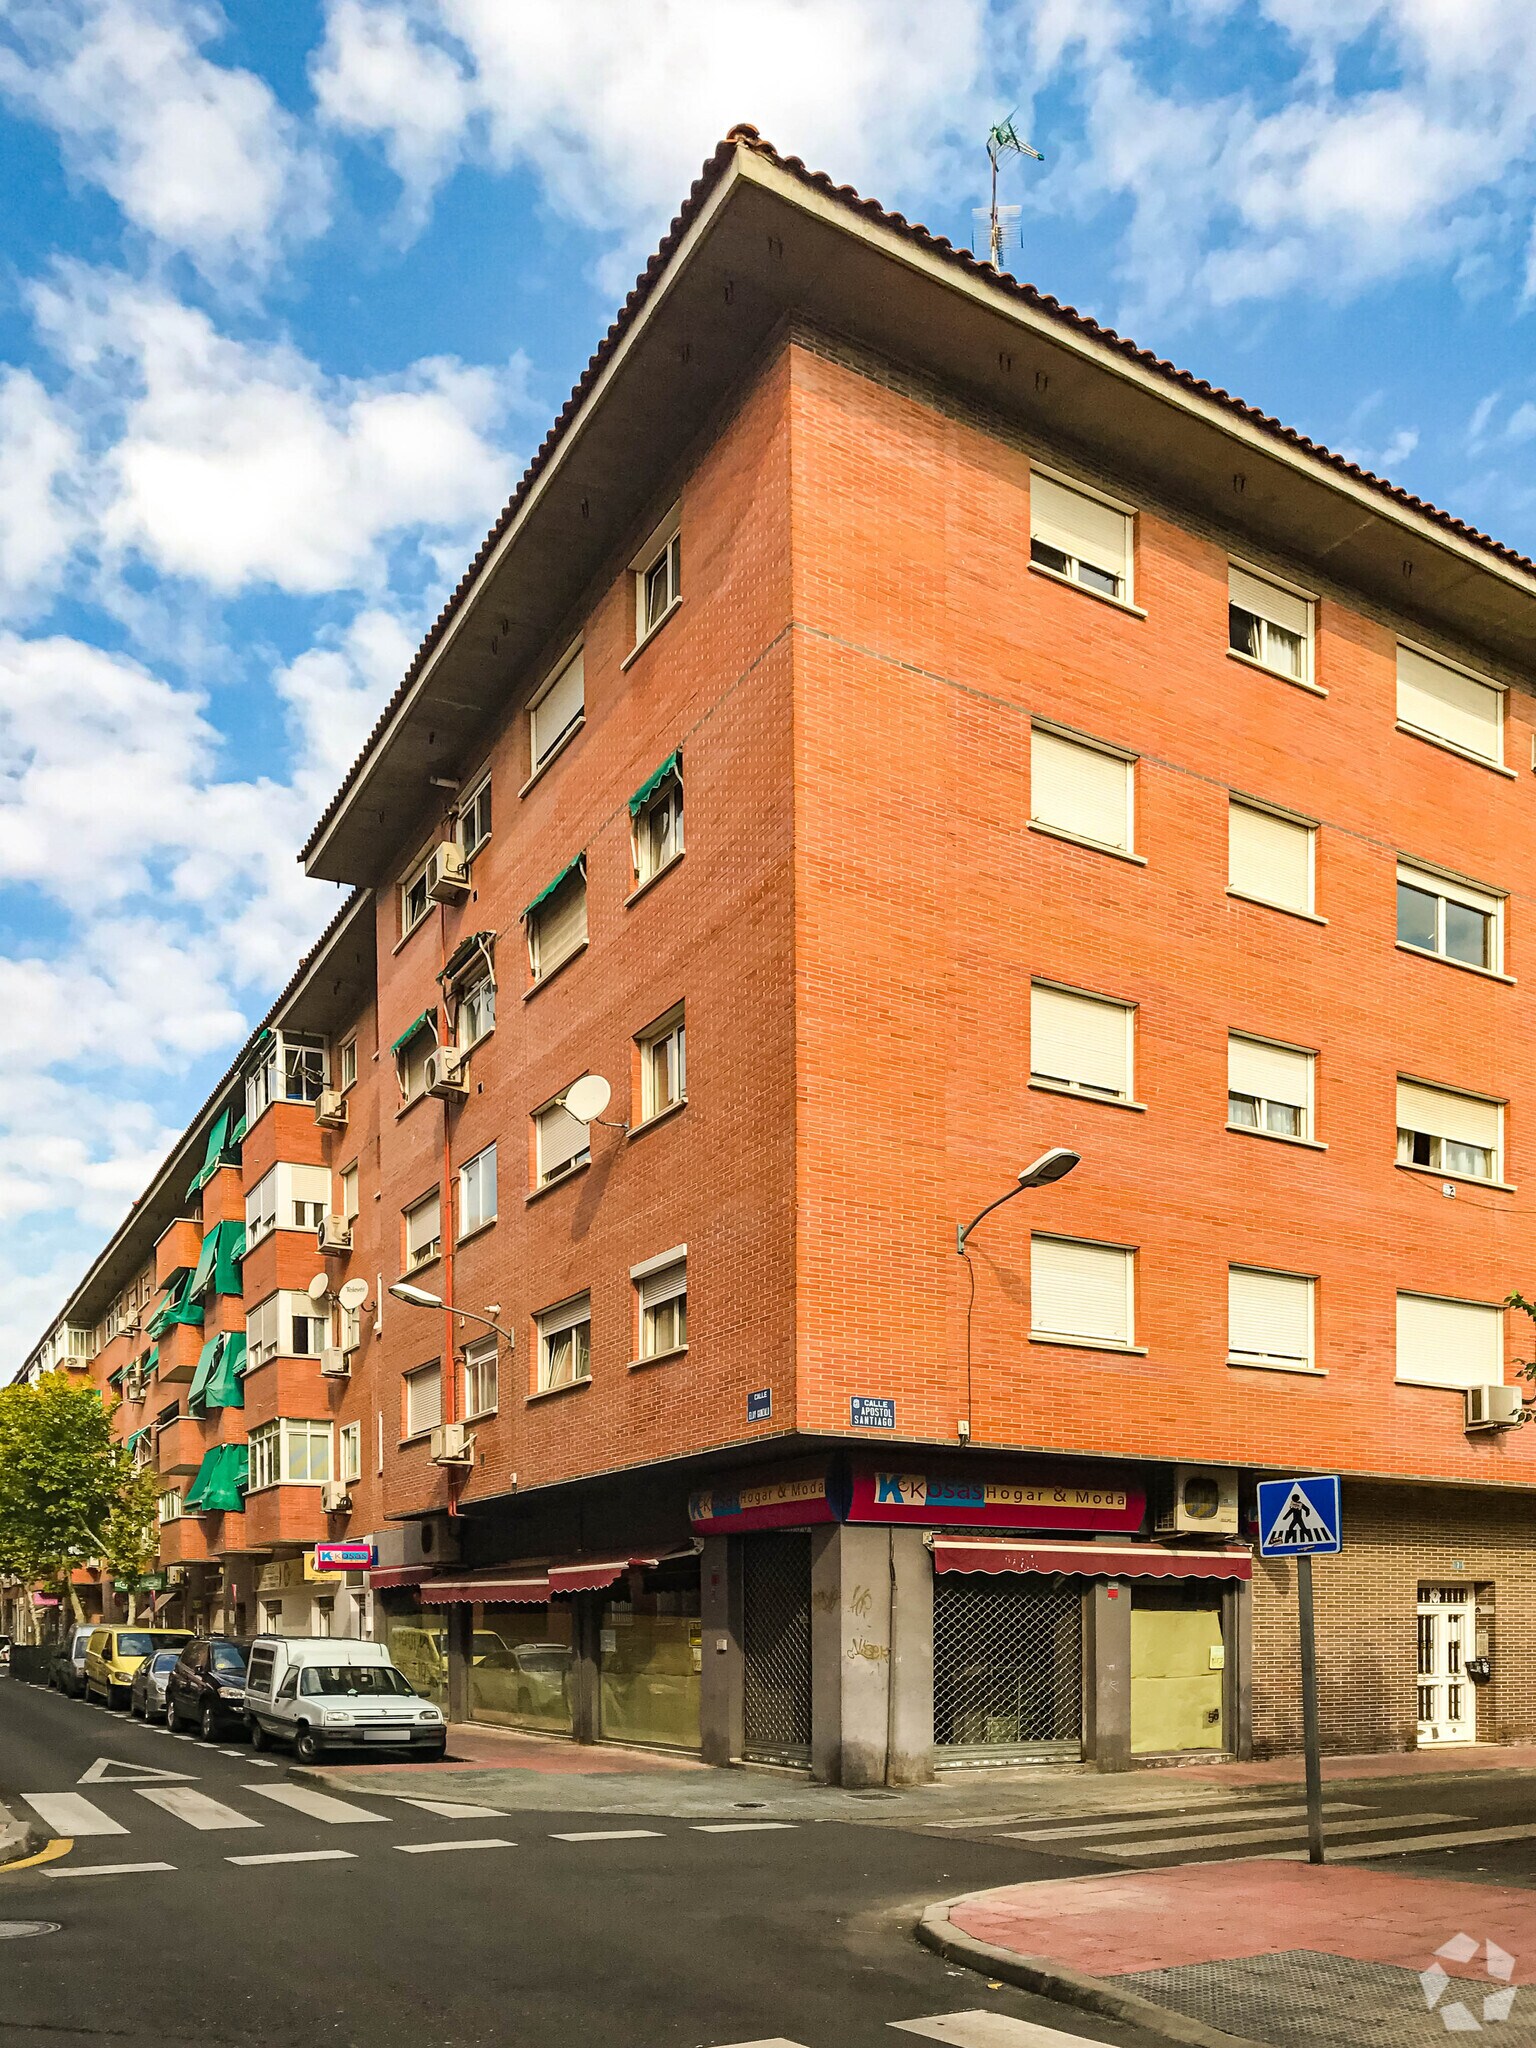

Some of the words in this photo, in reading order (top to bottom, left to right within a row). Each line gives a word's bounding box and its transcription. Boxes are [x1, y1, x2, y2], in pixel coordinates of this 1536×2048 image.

[754, 1391, 768, 1400] CALLE
[864, 1400, 888, 1408] CALLE
[861, 1407, 893, 1418] APOSTOL
[854, 1415, 893, 1427] SANTIAGO
[740, 1489, 772, 1506] Hogar
[777, 1484, 786, 1499] &
[791, 1480, 824, 1497] Moda
[986, 1486, 1044, 1503] Hogar
[1053, 1487, 1067, 1503] &
[1076, 1491, 1125, 1505] Moda
